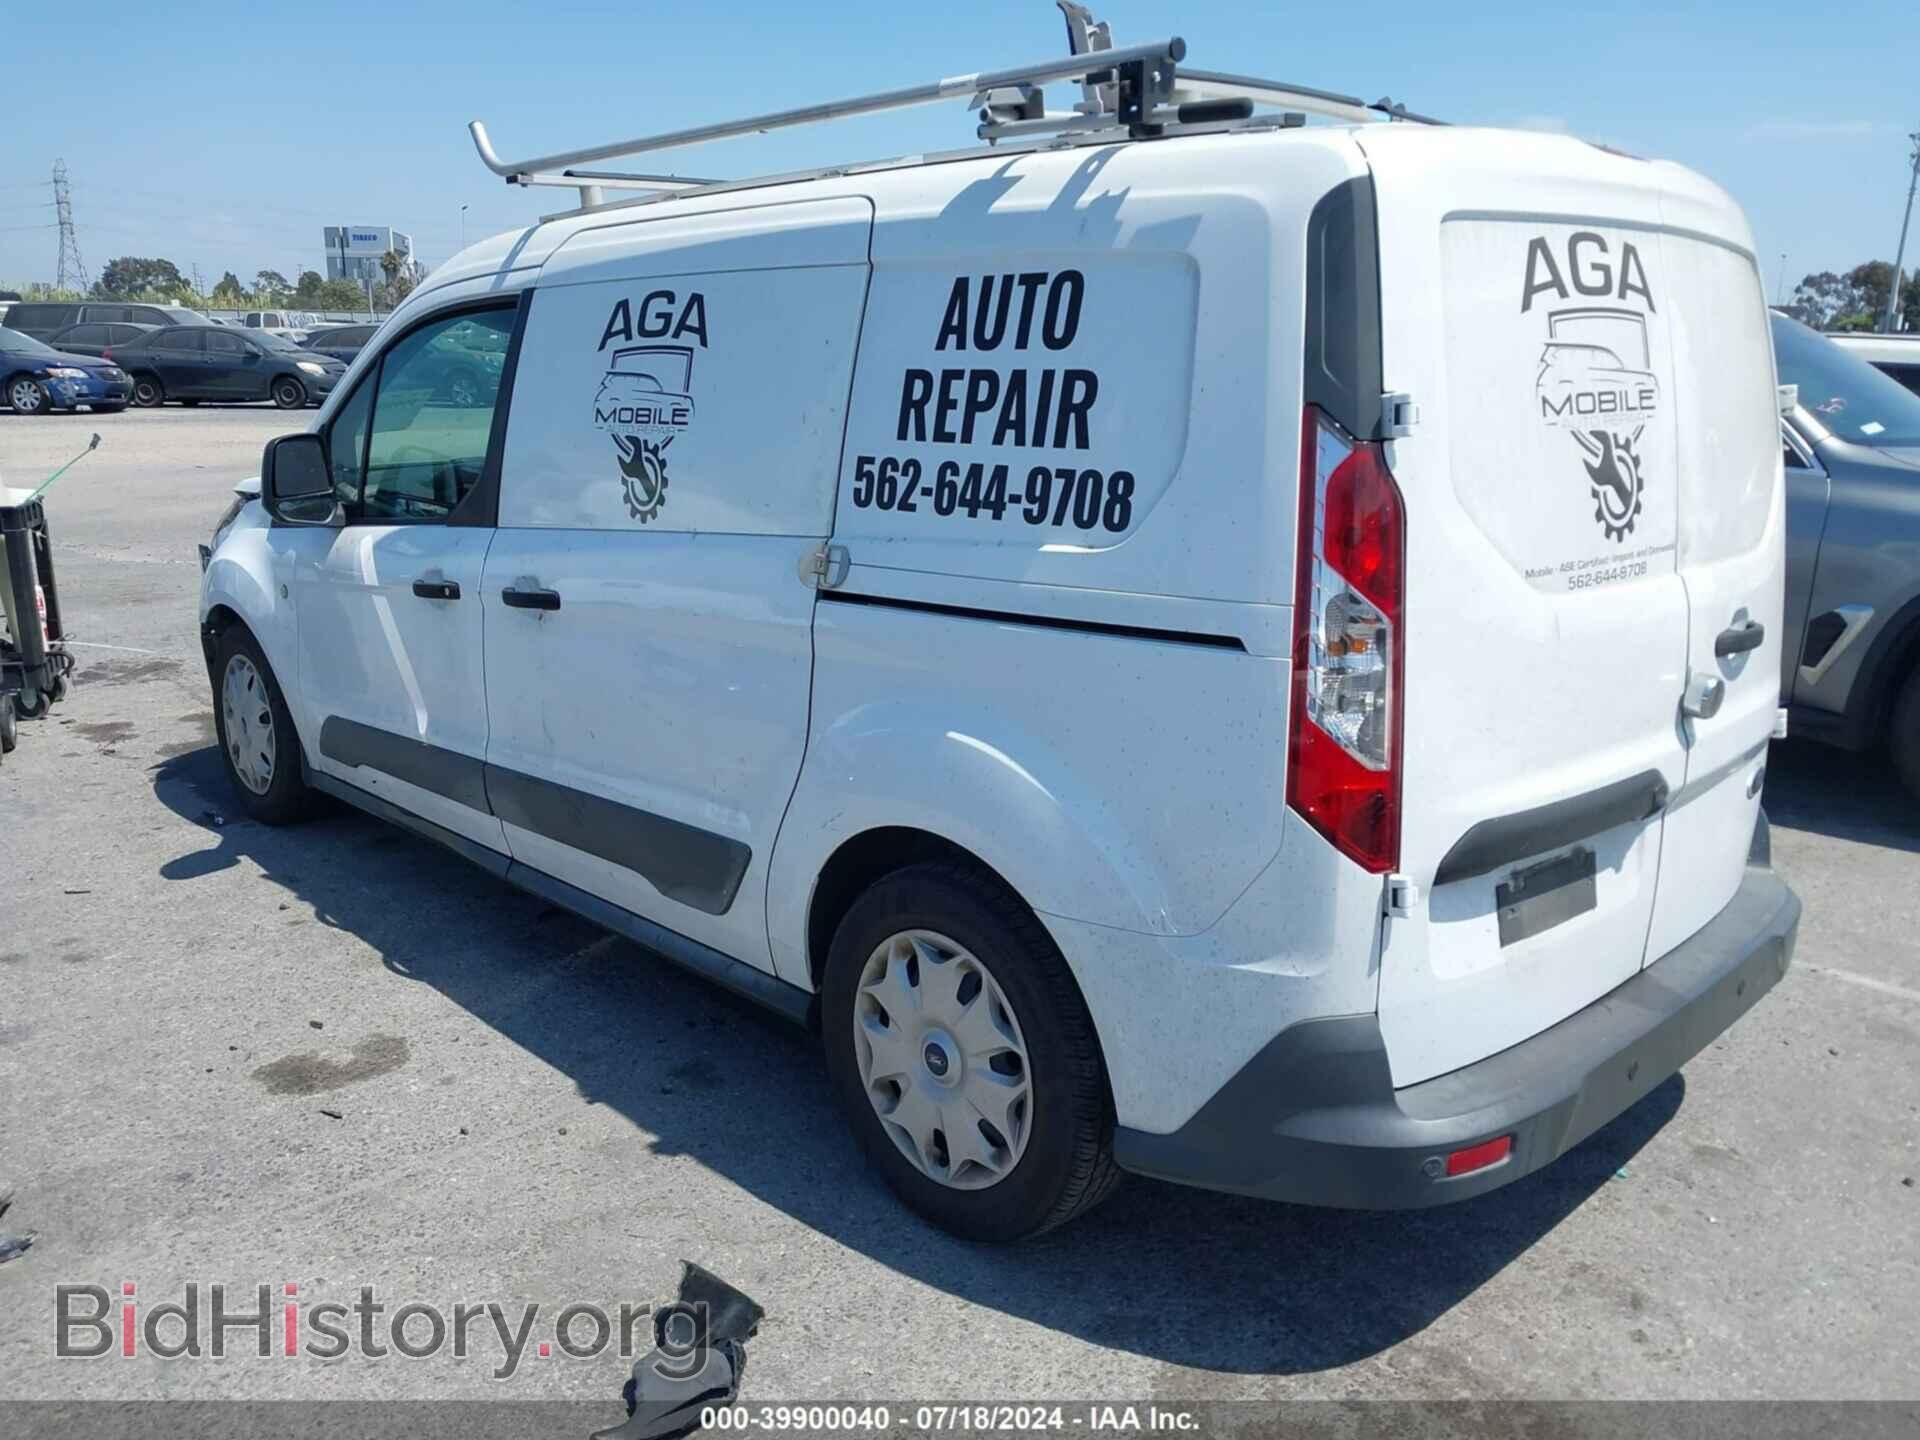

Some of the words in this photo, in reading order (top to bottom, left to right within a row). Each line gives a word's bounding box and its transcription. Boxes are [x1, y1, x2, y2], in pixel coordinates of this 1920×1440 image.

[1521, 232, 1656, 313] AGA
[598, 290, 709, 351] AGA
[935, 269, 1085, 351] AUTO
[594, 407, 689, 426] MOBILE
[897, 368, 1099, 450] REPAIR
[1541, 389, 1656, 417] MOBILE
[853, 455, 1135, 533] 562-644-9708
[1525, 564, 1554, 579] Mobile
[1568, 560, 1648, 590] 562-644-9708
